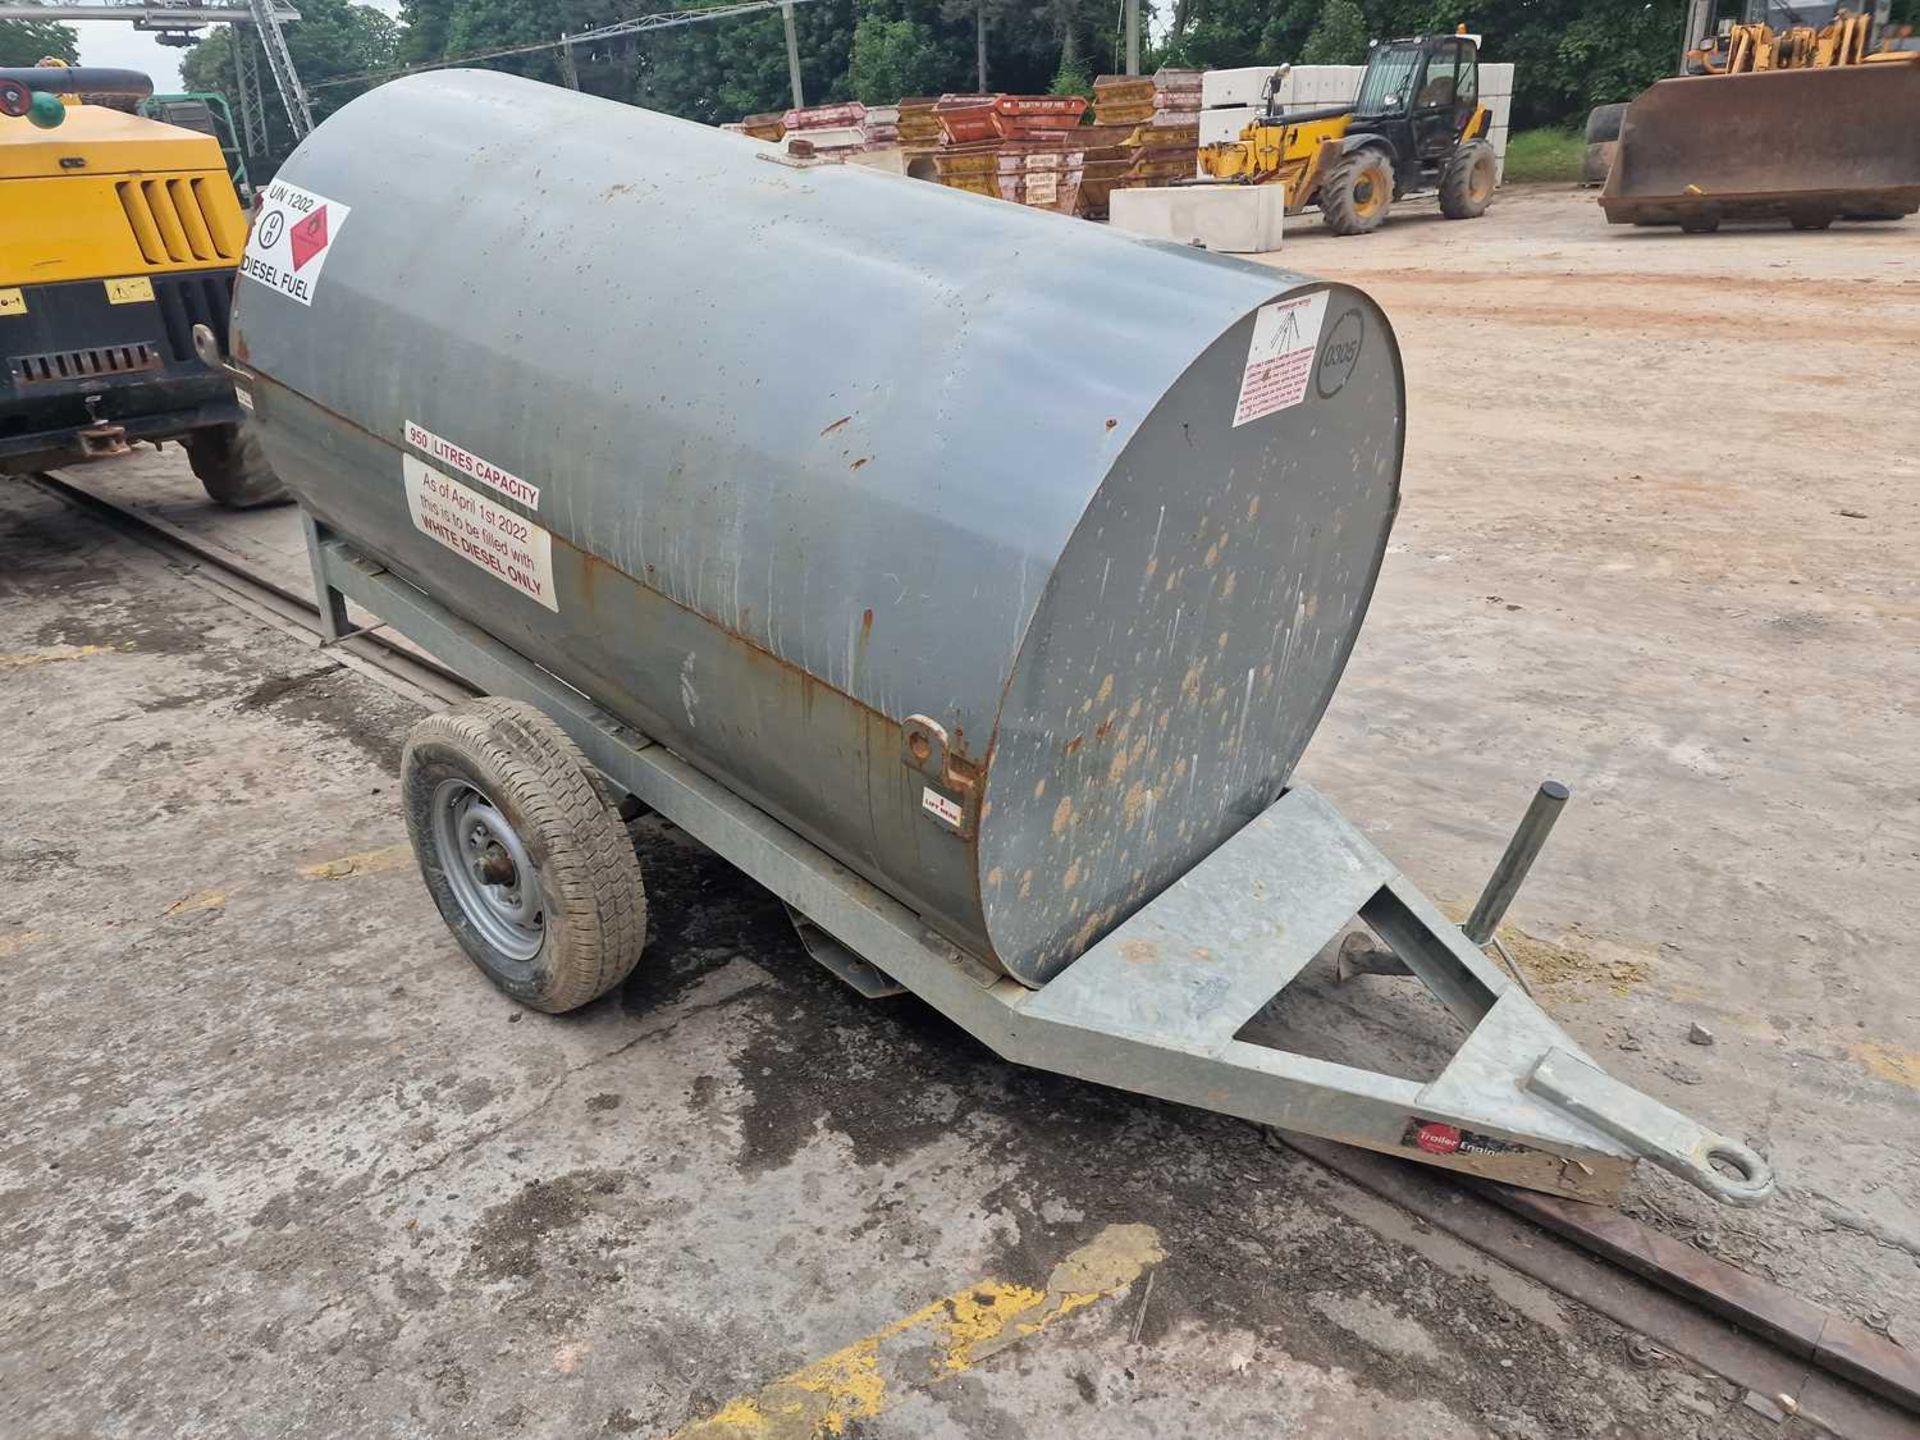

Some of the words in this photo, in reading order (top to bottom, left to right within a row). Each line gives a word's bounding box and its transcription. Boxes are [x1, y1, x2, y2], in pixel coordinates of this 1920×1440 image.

[269, 185, 287, 202] UN
[287, 193, 314, 213] 1202
[240, 255, 278, 286] DIESEL
[280, 272, 309, 301] FUEL
[410, 427, 427, 448] 950
[434, 439, 473, 472] LITRES
[475, 462, 537, 505] CAPACITY
[420, 493, 440, 516] this
[441, 505, 450, 521] is
[452, 511, 463, 530] to
[465, 520, 480, 540] be
[482, 528, 508, 556] filled
[511, 547, 535, 571] with
[423, 472, 437, 493] As
[438, 482, 450, 500] of
[452, 488, 476, 514] April
[480, 504, 496, 526] 1st
[499, 515, 528, 544] 2022
[420, 514, 458, 550] WHITE
[461, 536, 506, 576] DIESEL
[508, 565, 542, 596] ONLY
[1420, 1131, 1458, 1147] Trailer
